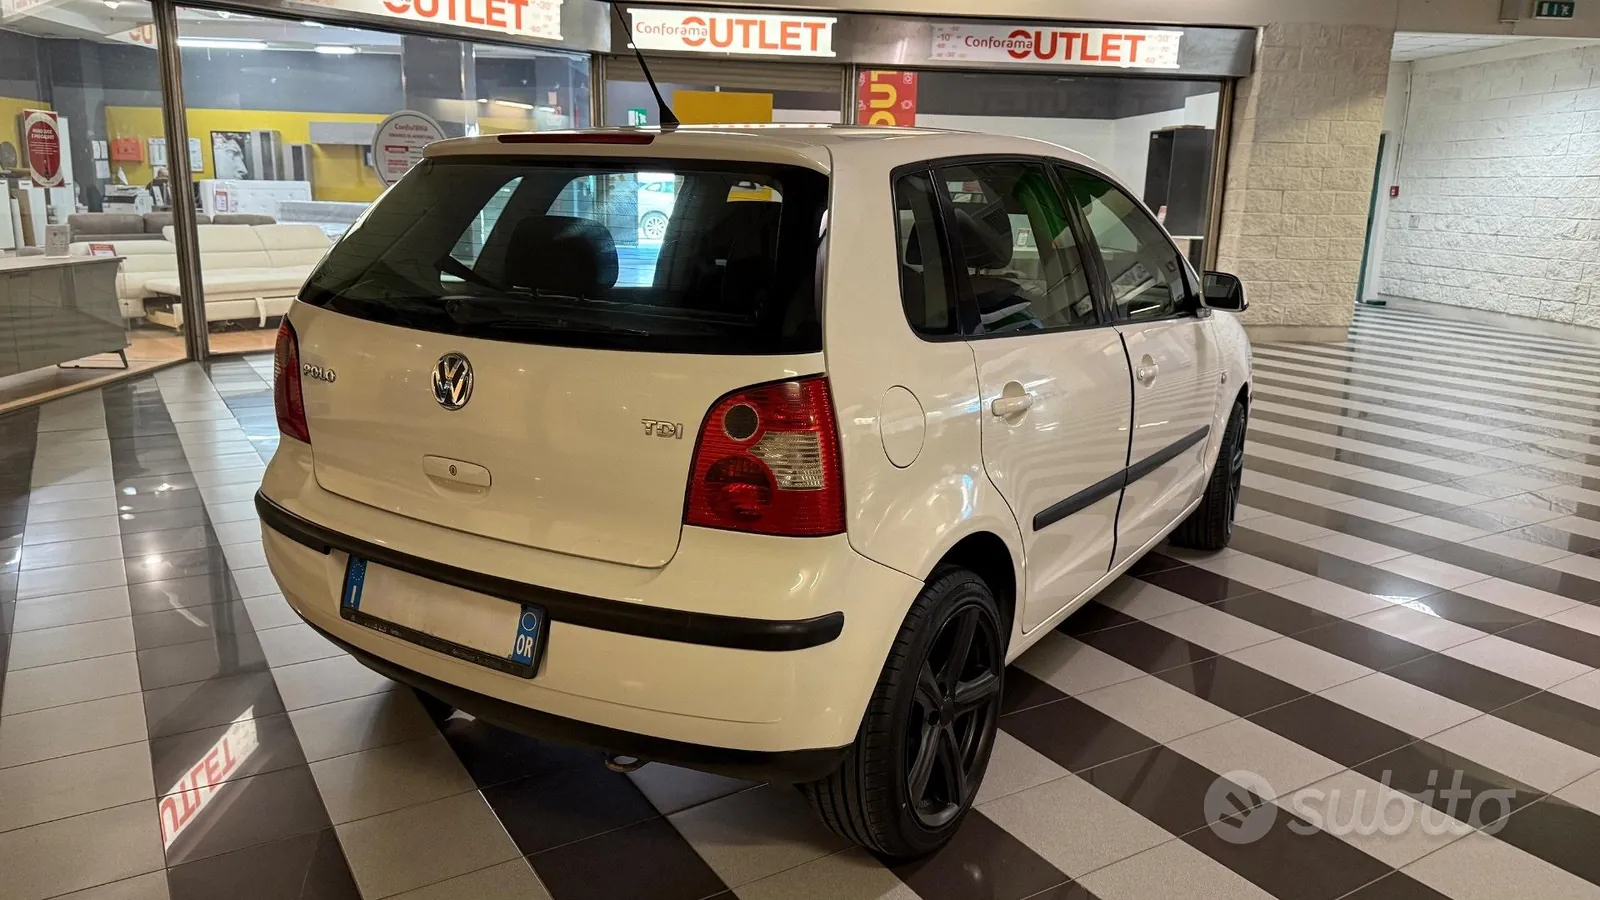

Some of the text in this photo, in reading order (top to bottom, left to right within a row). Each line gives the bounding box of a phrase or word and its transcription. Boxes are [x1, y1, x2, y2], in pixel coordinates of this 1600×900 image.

[636, 16, 826, 52] Conforama OUTLET
[964, 29, 1146, 63] Conforama OUTLET
[303, 363, 336, 383] POLO
[641, 418, 684, 439] TDI
[516, 634, 534, 658] OR
